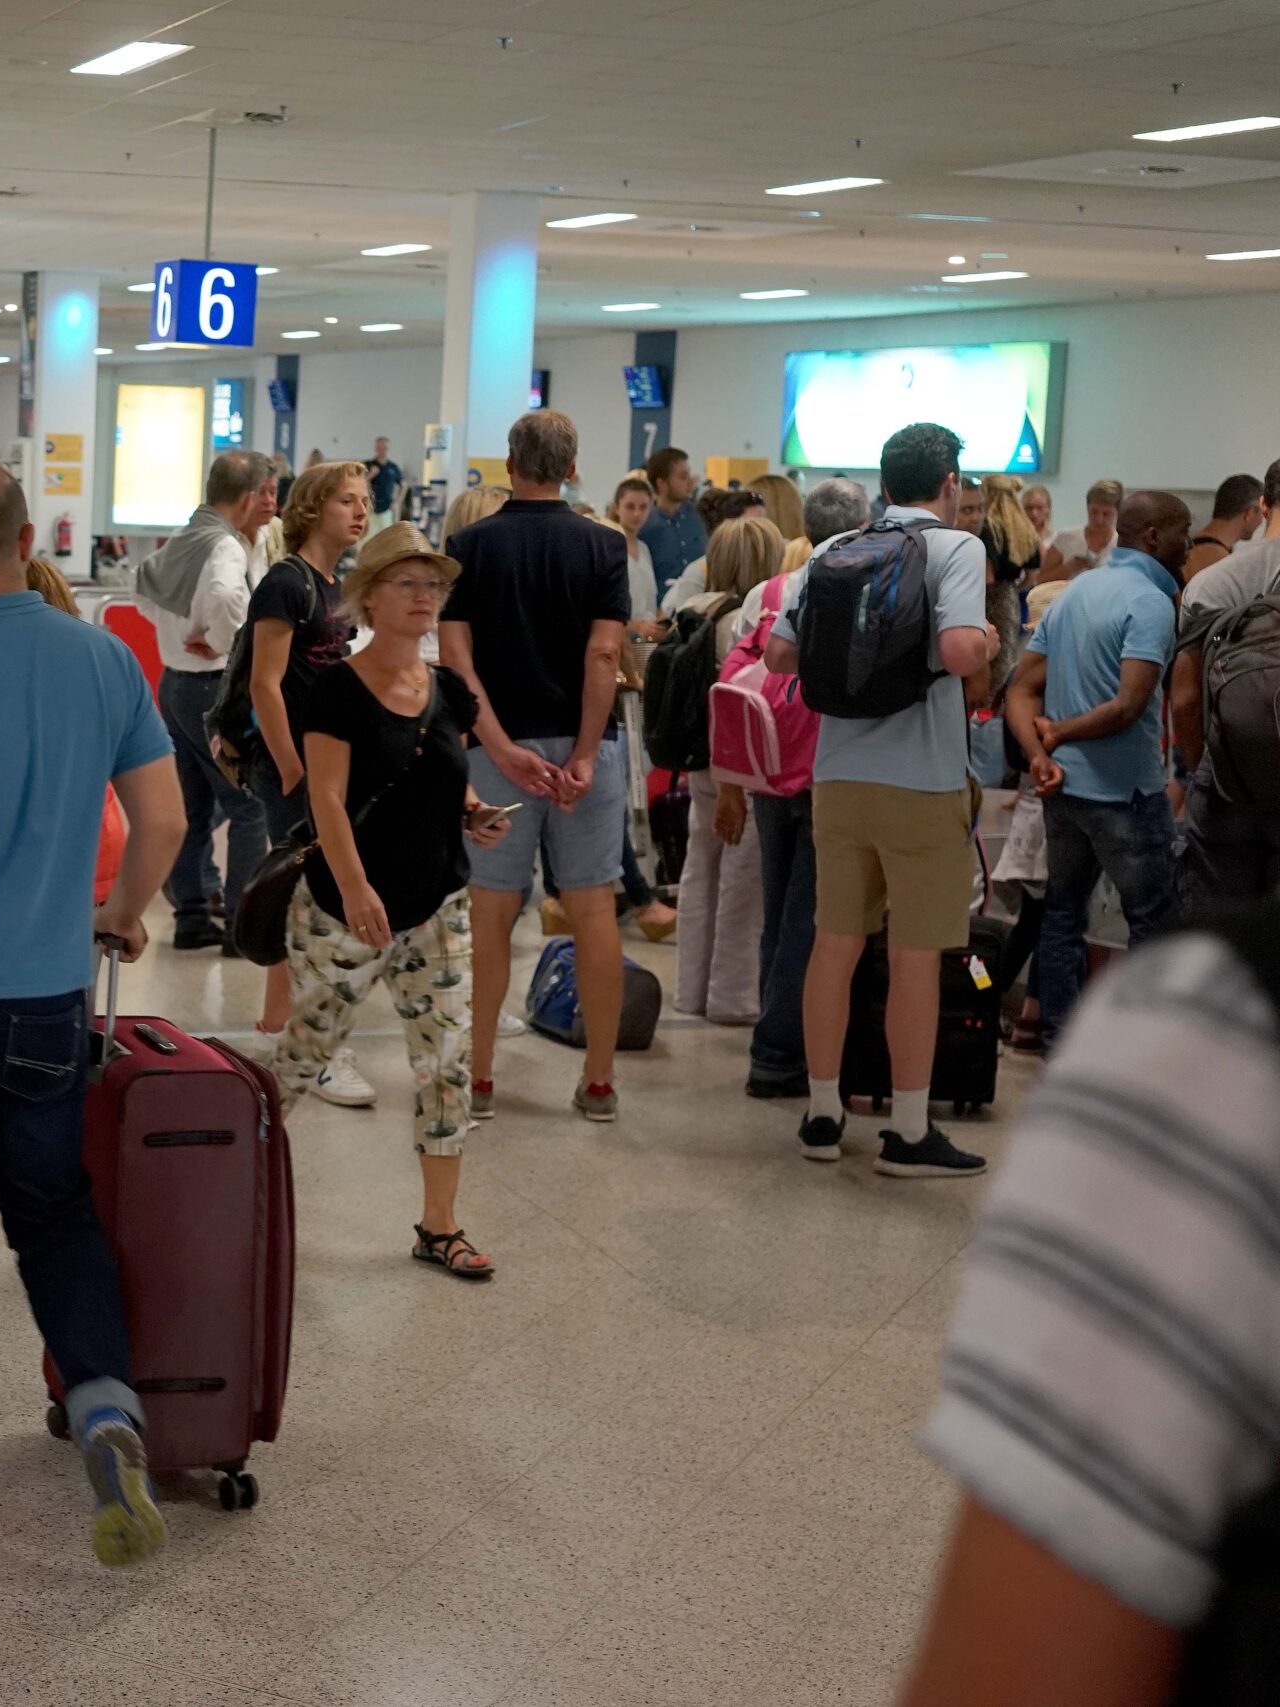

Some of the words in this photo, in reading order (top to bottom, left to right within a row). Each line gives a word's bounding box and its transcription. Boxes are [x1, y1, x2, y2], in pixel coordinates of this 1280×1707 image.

[157, 266, 173, 338] 6
[199, 267, 236, 340] 6
[643, 422, 658, 462] 7
